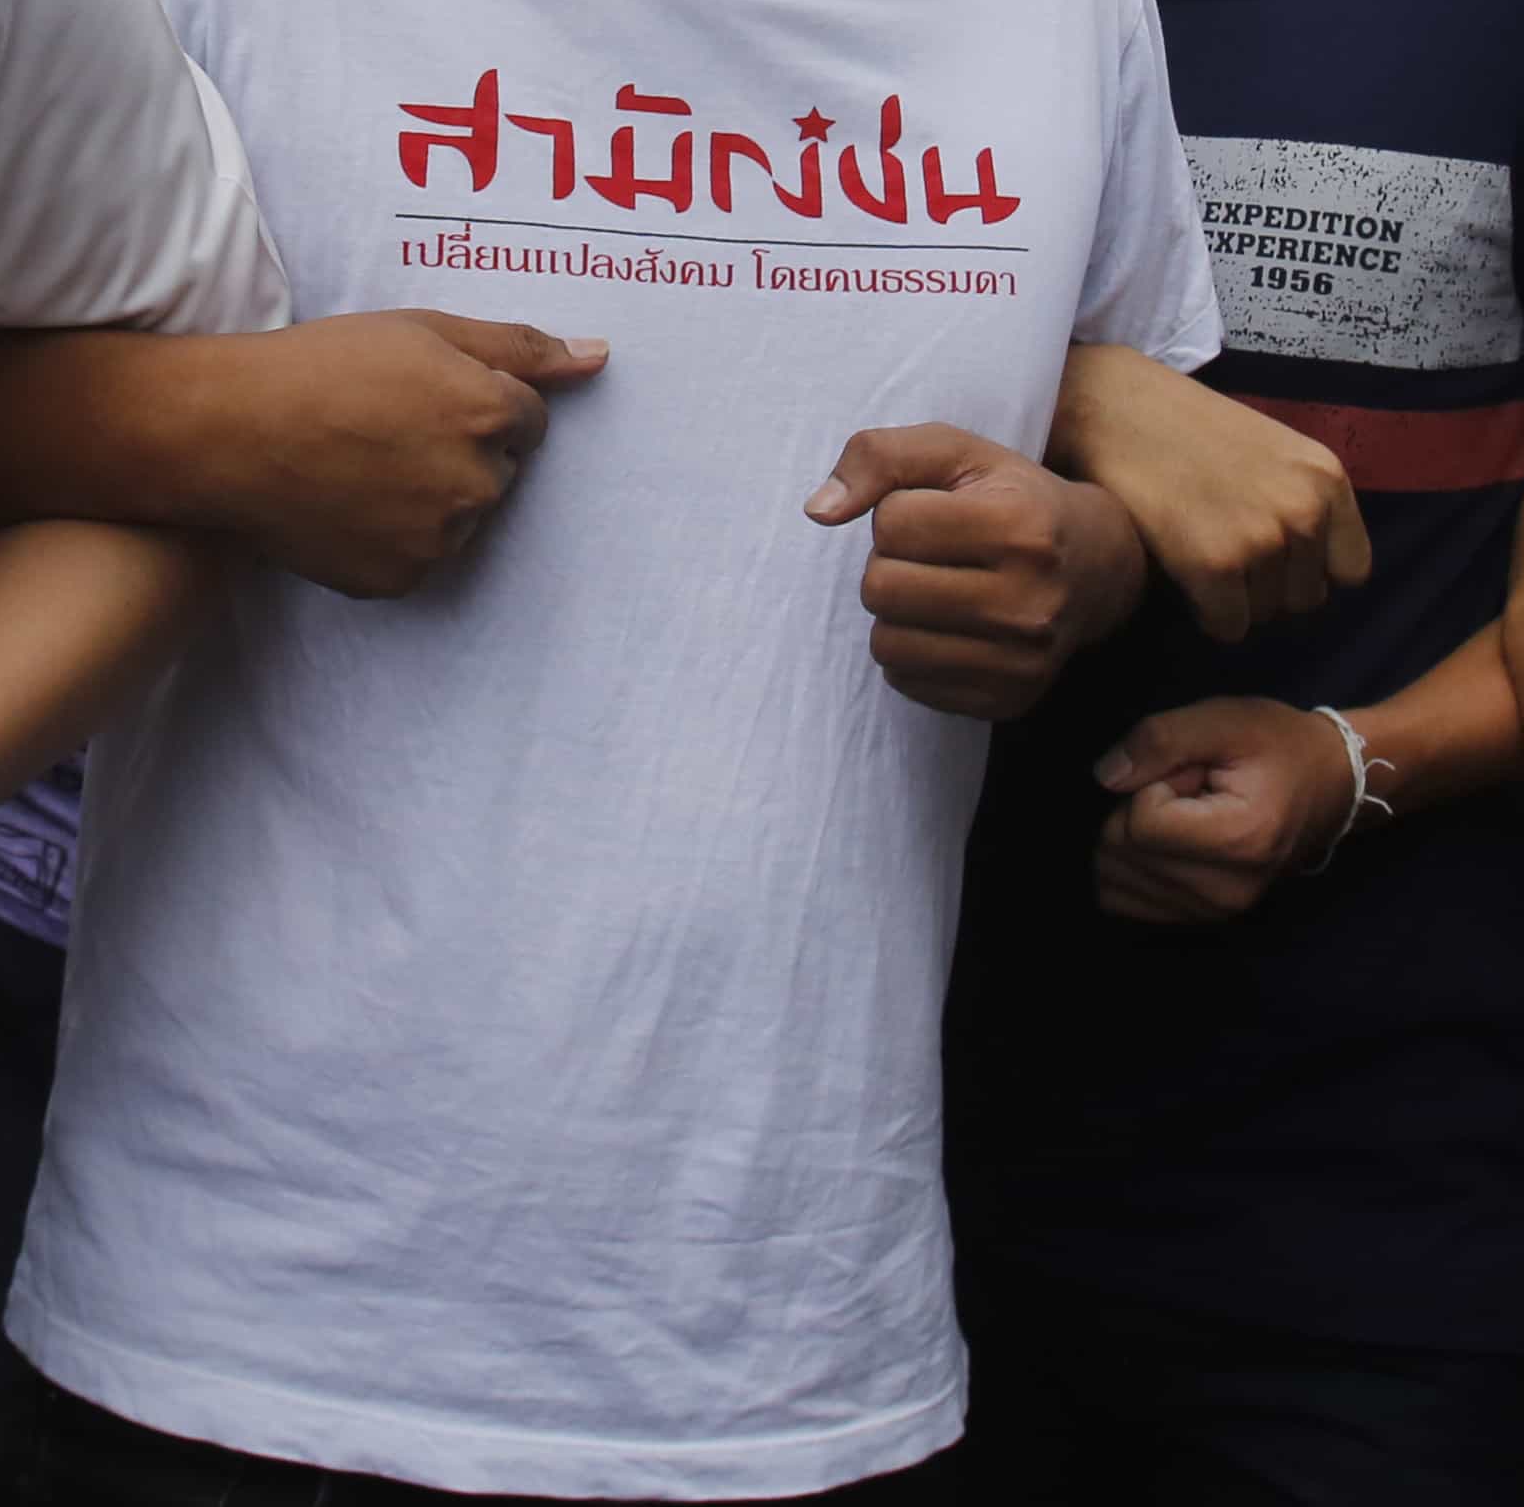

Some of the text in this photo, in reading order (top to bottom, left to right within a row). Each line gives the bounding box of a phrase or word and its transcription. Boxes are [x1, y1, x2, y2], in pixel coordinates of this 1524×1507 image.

[1202, 201, 1404, 243] EXPEDITION
[401, 222, 1018, 295] เปลี่ยนแปลงสังคม โดยคนธรรมดา
[1250, 264, 1335, 296] 1956
